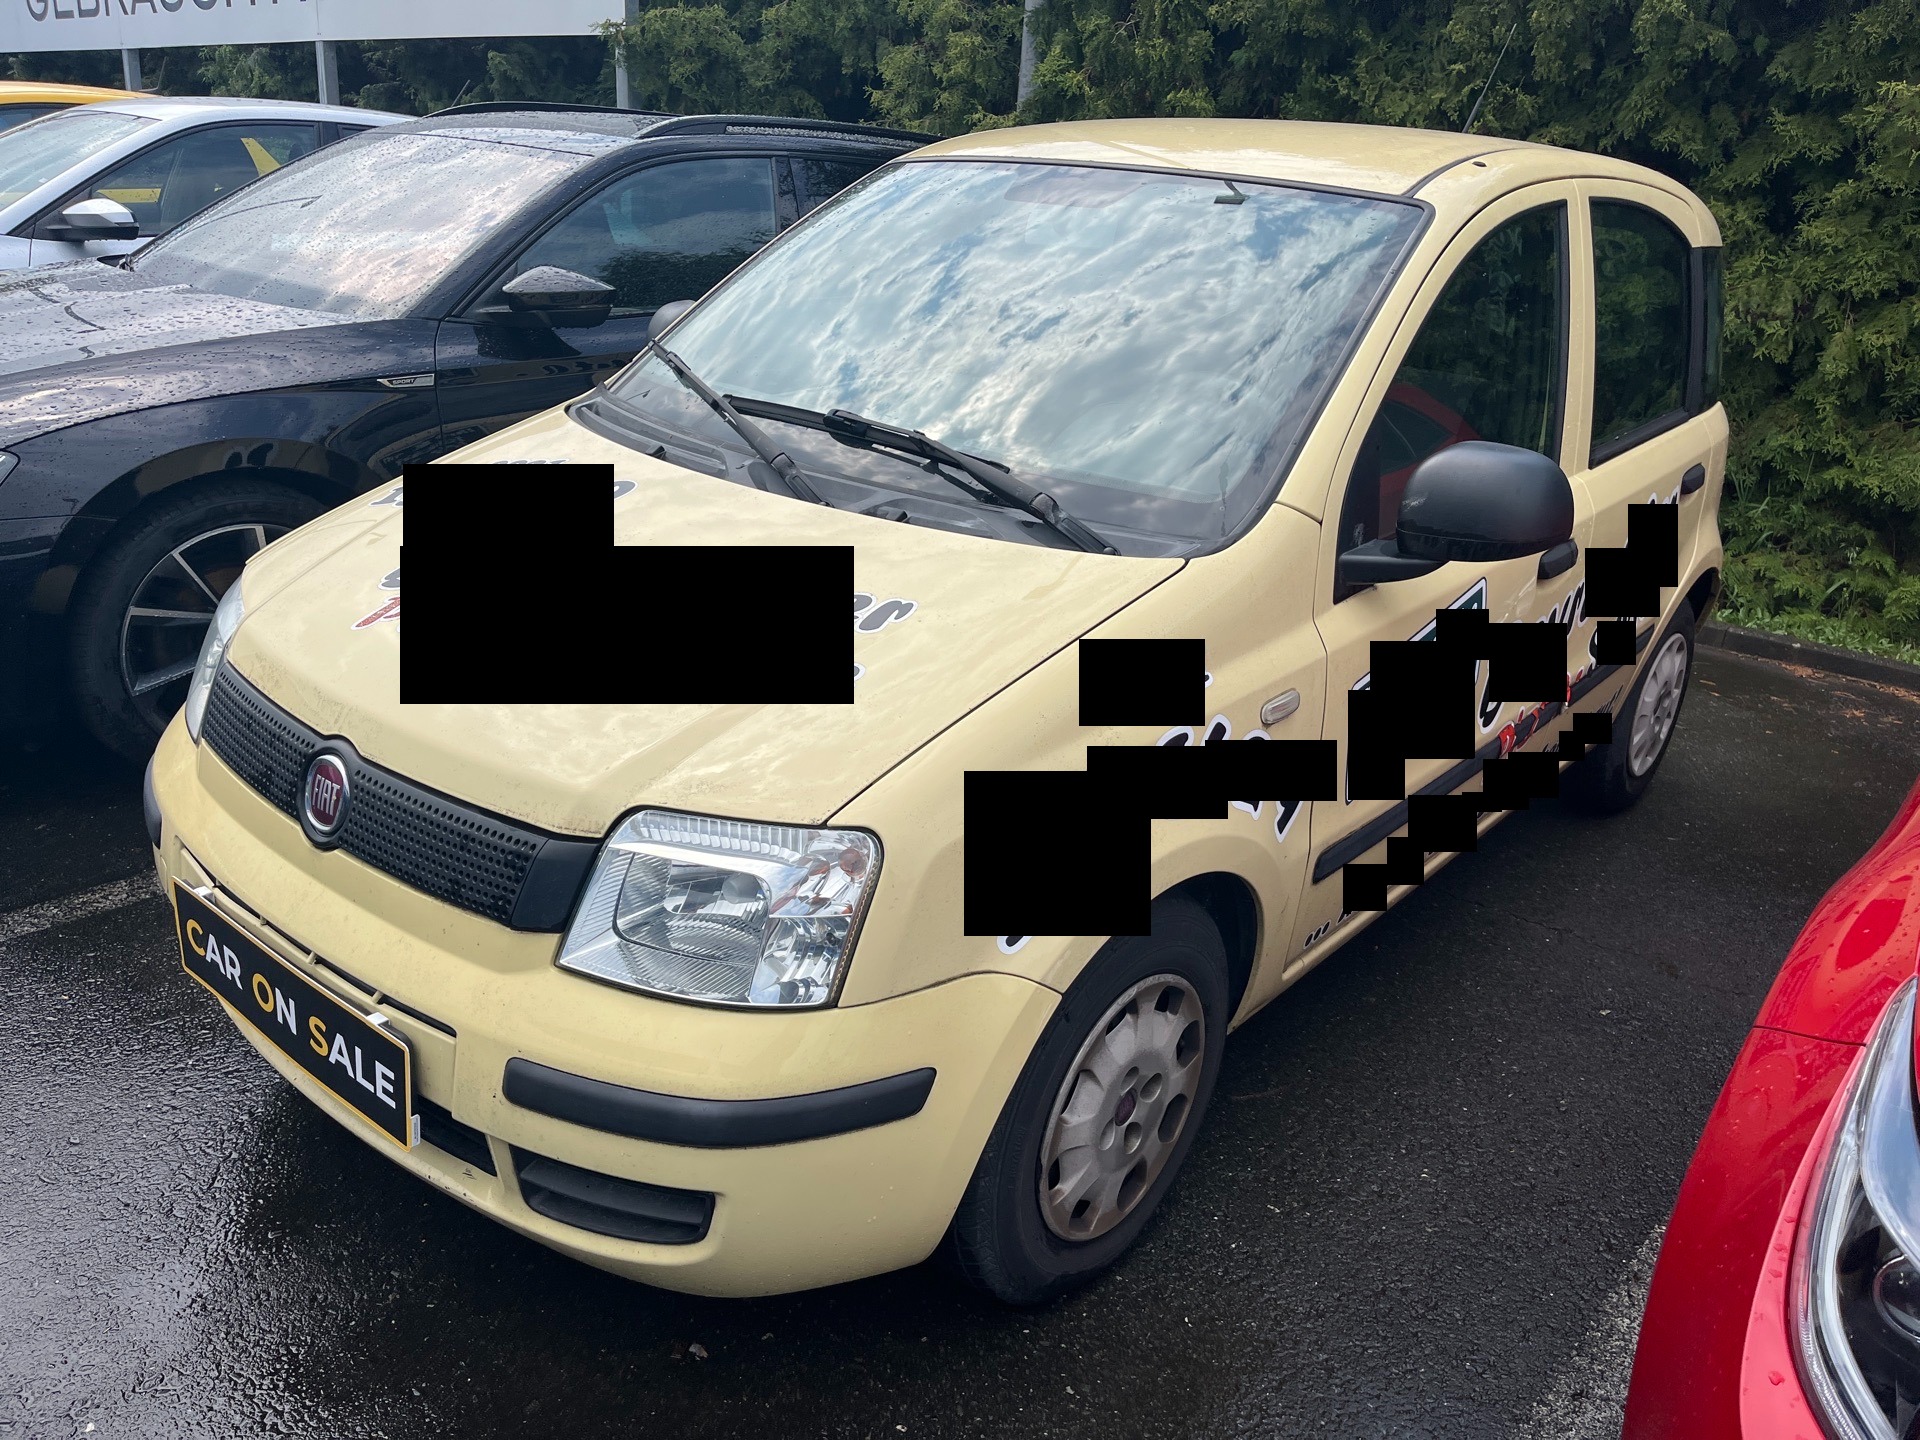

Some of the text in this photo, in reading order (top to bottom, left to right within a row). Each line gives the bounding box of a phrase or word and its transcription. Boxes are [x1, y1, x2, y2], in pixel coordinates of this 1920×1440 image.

[312, 774, 341, 816] FIAT
[186, 919, 396, 1109] CAR ON SALE
